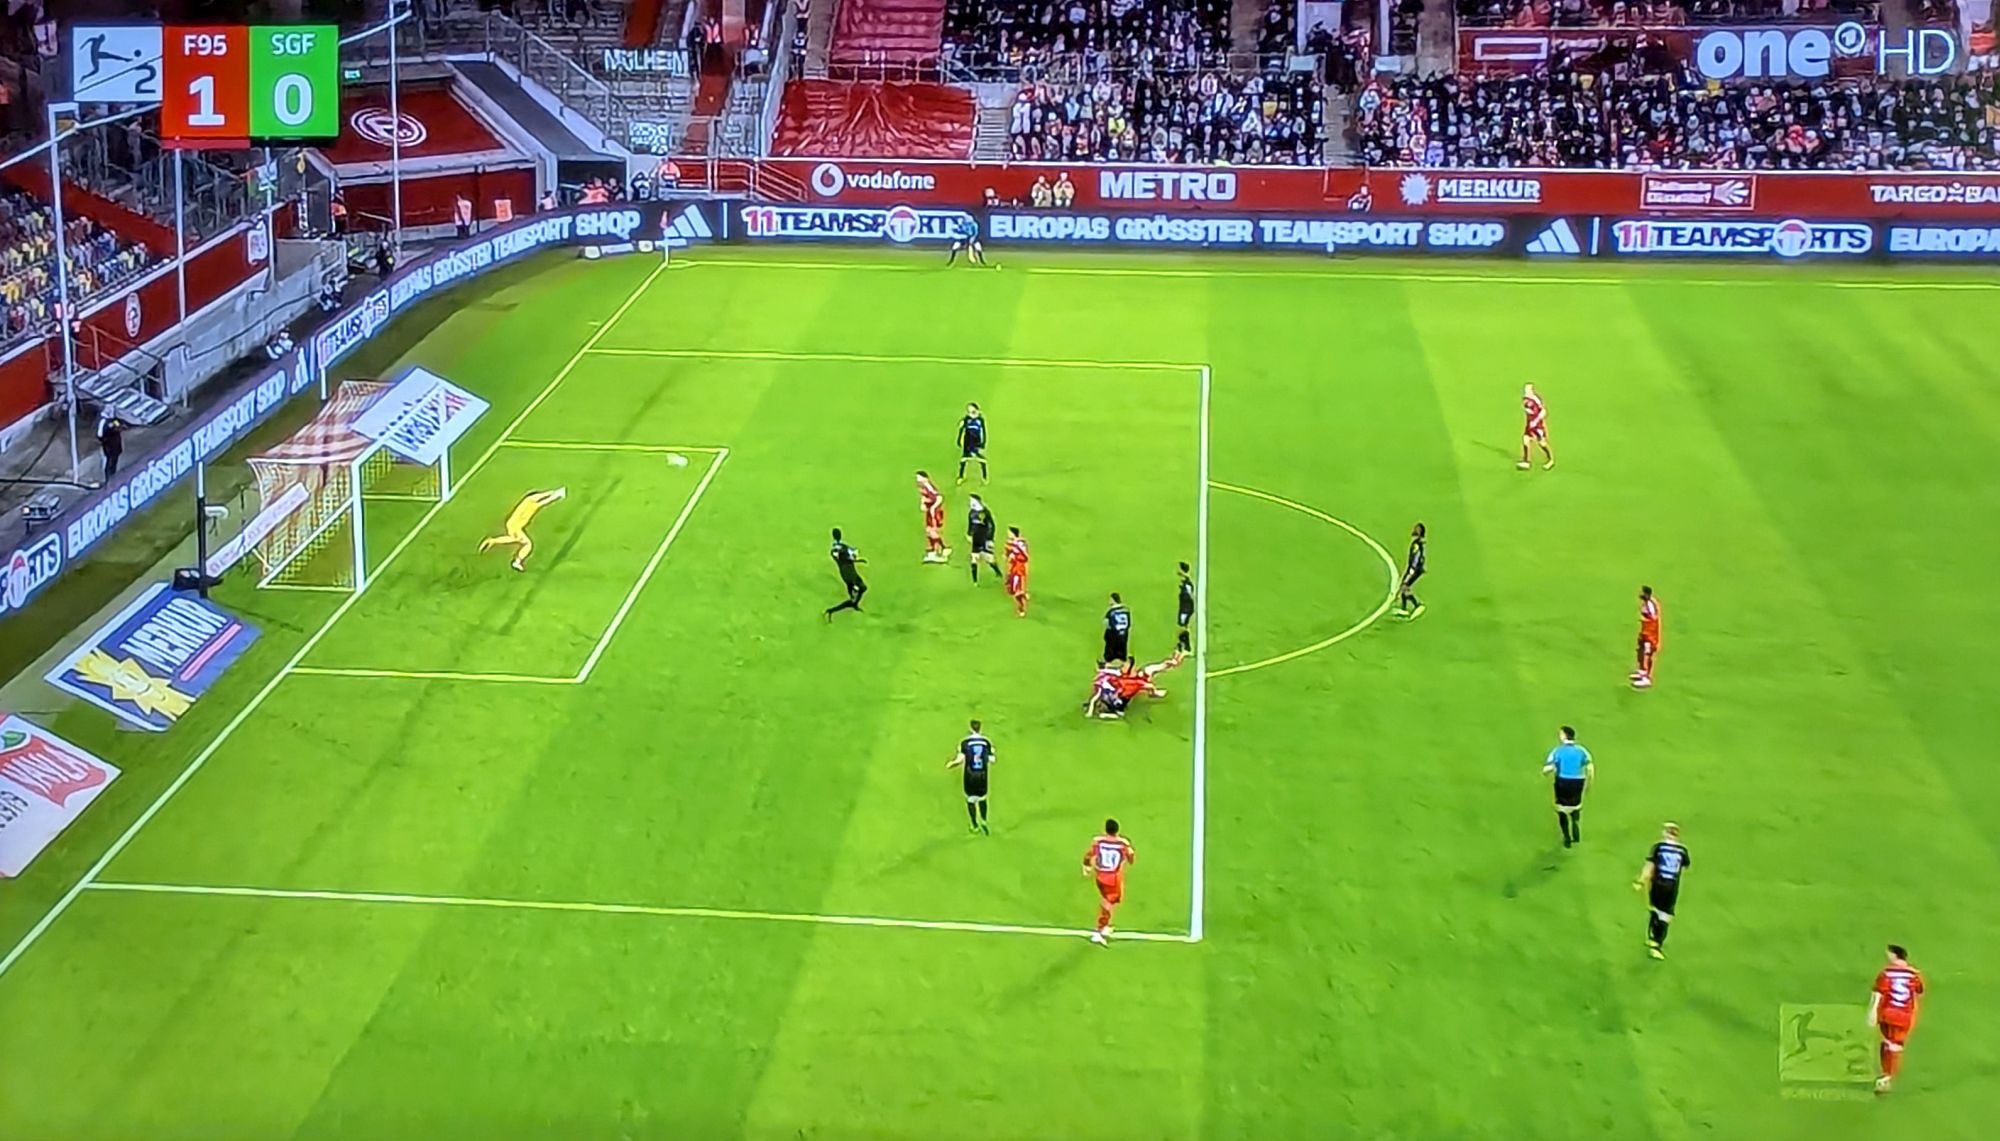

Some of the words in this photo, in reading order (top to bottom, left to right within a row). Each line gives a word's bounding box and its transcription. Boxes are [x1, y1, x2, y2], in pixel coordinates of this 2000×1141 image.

[847, 170, 935, 190] vodafone
[1100, 171, 1236, 201] METRO
[1437, 178, 1541, 199] MERKUR
[575, 210, 641, 238] SHOP
[990, 214, 1109, 239] EUROPAS
[1116, 215, 1253, 243] GRÖSSTER
[1259, 219, 1424, 246] TEAMSPORT
[1428, 222, 1504, 246] SHOP
[118, 598, 228, 674] MERKUR
